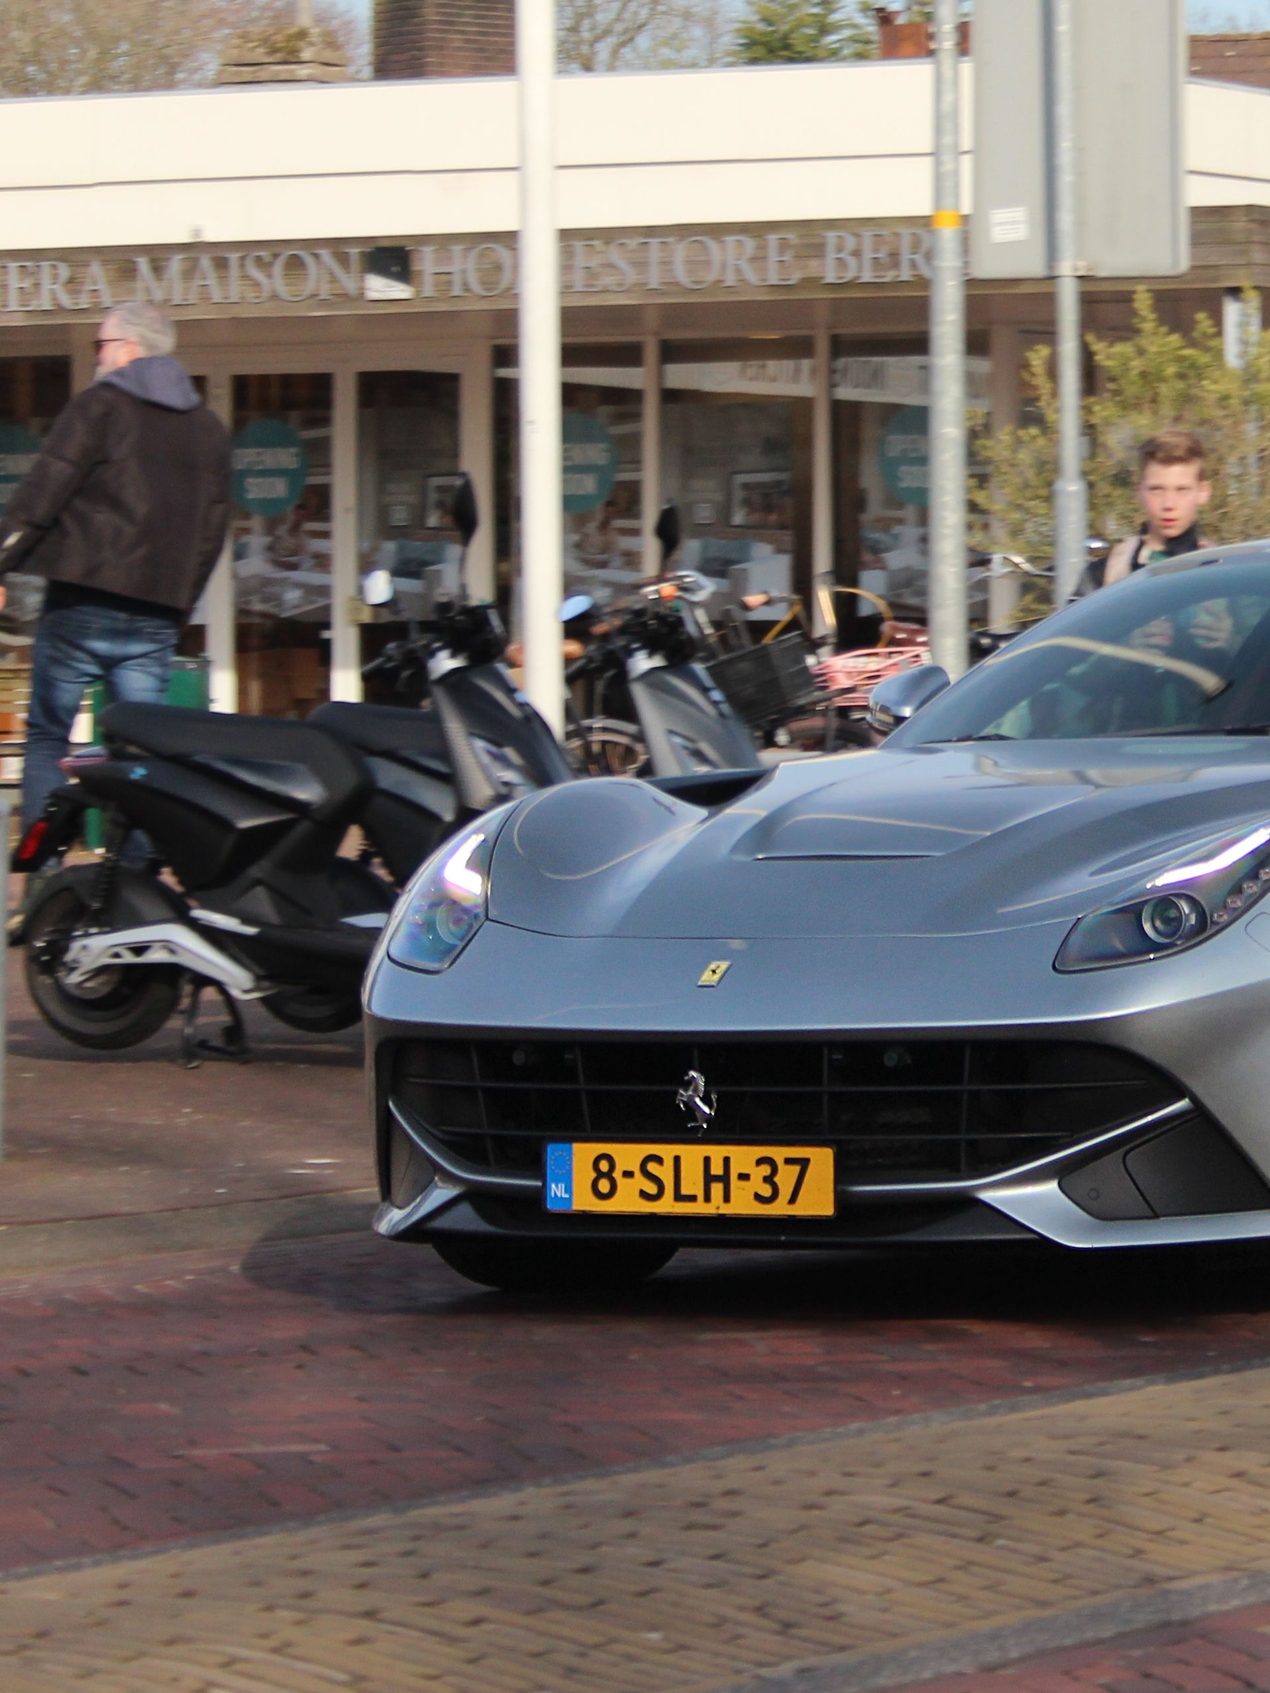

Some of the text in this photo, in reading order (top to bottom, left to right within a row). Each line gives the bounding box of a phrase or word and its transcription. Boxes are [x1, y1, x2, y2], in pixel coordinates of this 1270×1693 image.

[134, 247, 364, 306] MAISON
[404, 233, 800, 299] HOESTORE
[551, 1183, 570, 1198] NL
[591, 1152, 812, 1206] 8-SLH-37
